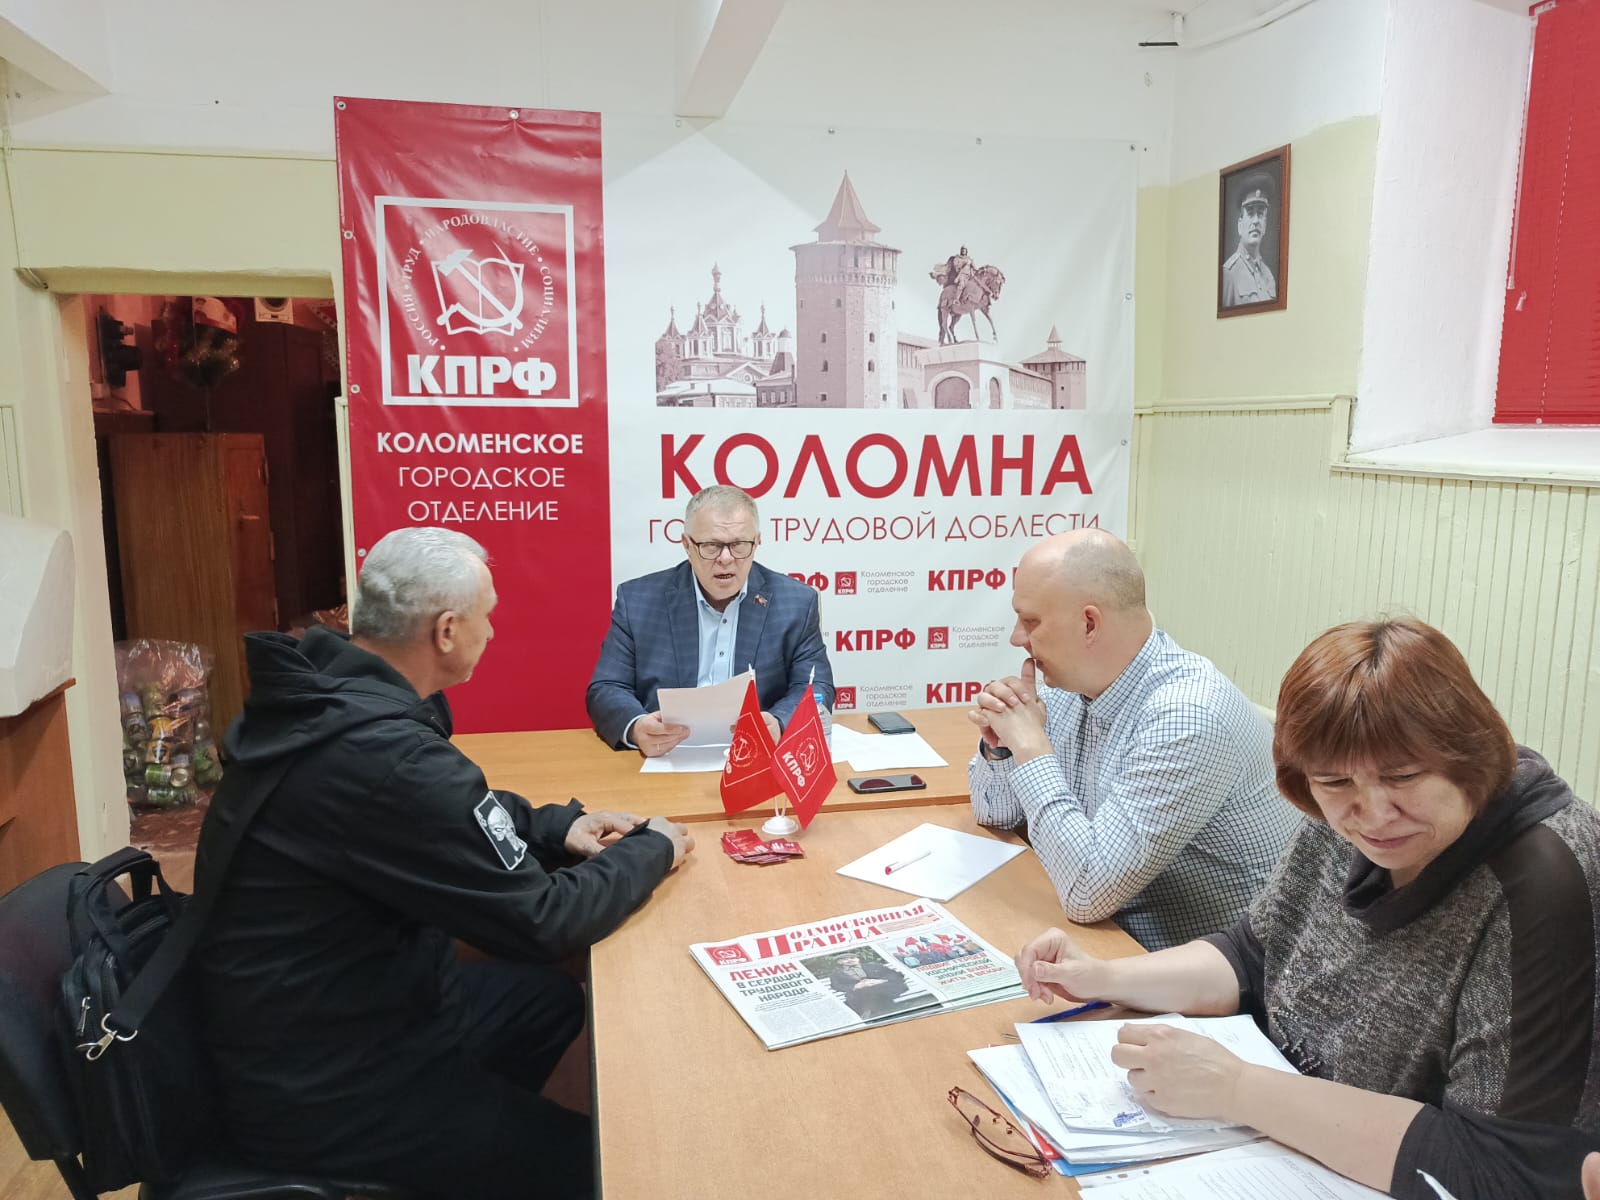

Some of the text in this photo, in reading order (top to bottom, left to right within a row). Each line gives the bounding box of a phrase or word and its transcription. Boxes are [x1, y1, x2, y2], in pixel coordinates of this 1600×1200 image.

[402, 248, 421, 281] ТРУД
[402, 293, 439, 346] РОССИЯ
[407, 354, 557, 395] КПРФ
[377, 432, 583, 454] КОЛОМЕНСКОЕ
[661, 432, 1093, 499] КОЛОМНА
[399, 466, 565, 490] ГОРОДСКОЕ
[407, 500, 559, 523] ОТДЕЛЕНИЕ
[770, 510, 1099, 544] ТРУДОВОЙ ДОБЛЕСТИ
[928, 568, 1006, 591] КПРФ
[835, 628, 916, 652] КПРФ
[926, 682, 983, 704] КПР
[782, 752, 805, 787] КПРФ
[730, 962, 798, 981] ЛЕНИН
[736, 972, 805, 989] В СЕРДЦАХ
[740, 978, 813, 996] ТРУДОВОГО
[758, 987, 809, 1002] НАРОДА
